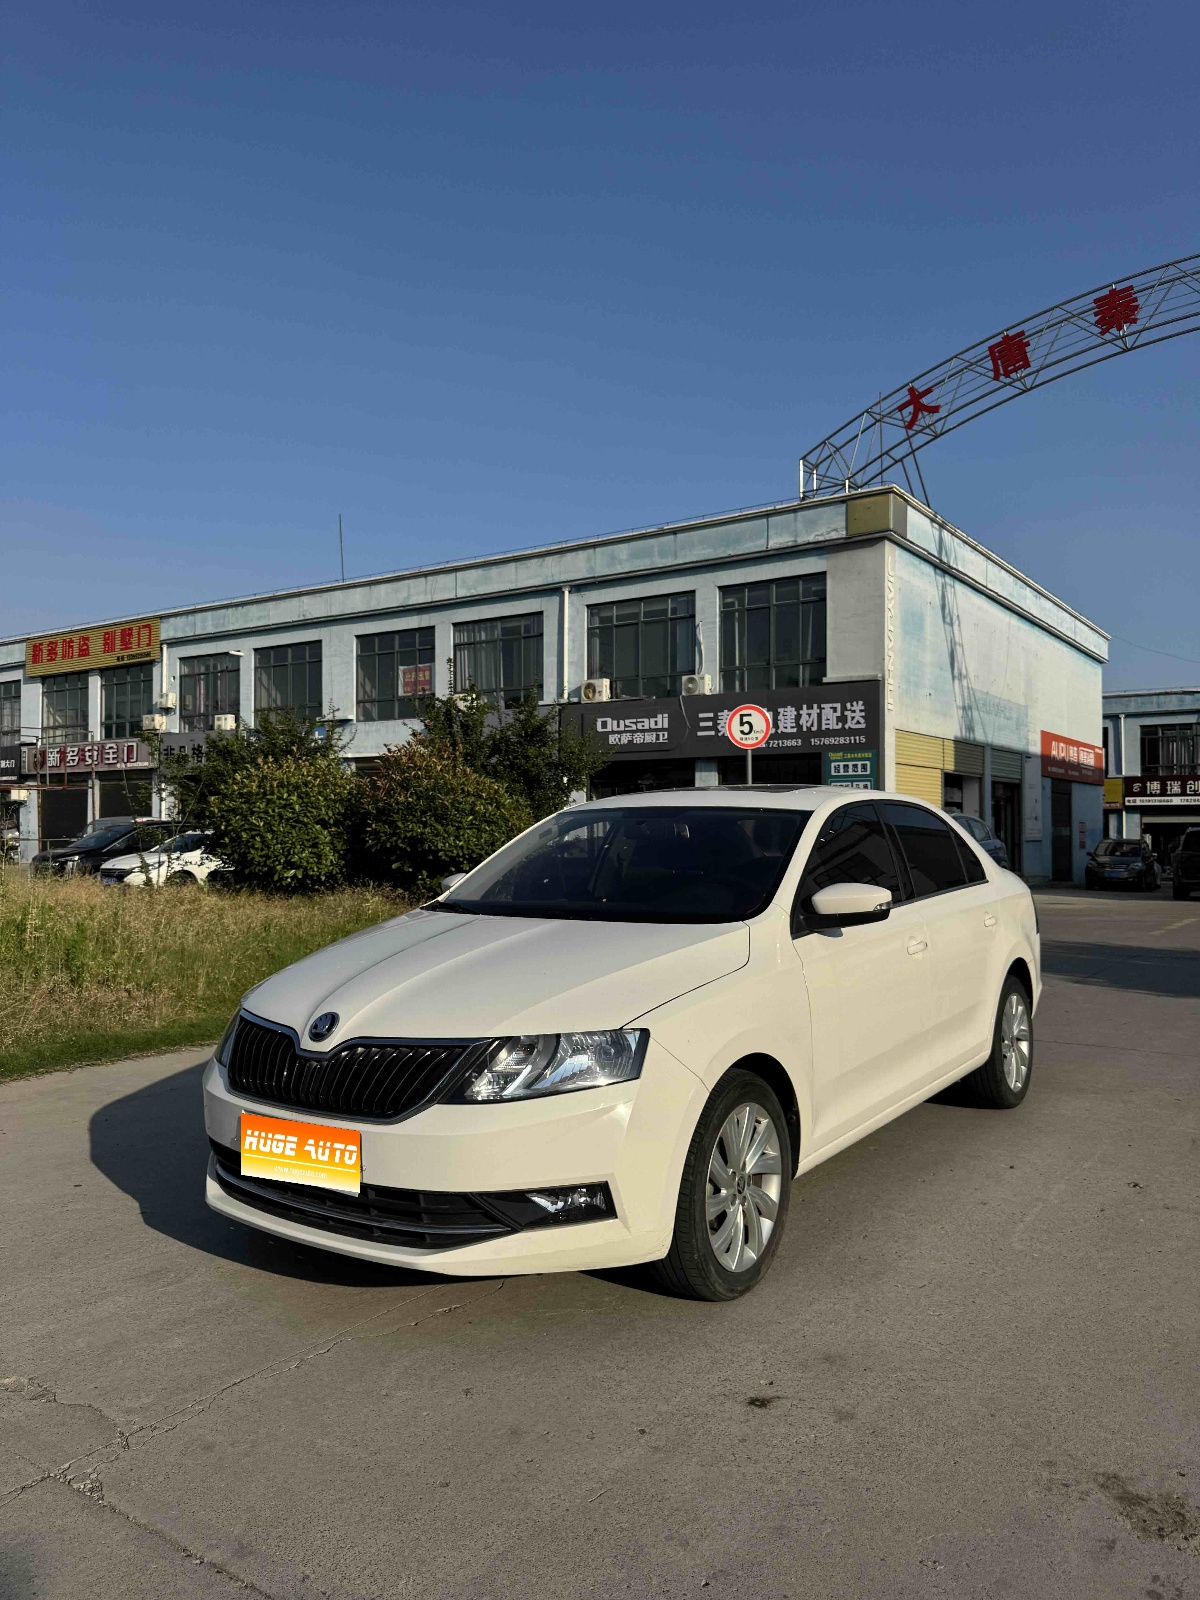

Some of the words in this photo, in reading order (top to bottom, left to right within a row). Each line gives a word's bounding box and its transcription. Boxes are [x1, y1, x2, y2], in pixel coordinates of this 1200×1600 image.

[31, 636, 90, 664] 新多防盗
[102, 624, 152, 653] 别墅门
[739, 713, 754, 735] 5
[608, 731, 669, 744] 欧萨帝厨卫
[810, 736, 866, 746] 15769283115
[47, 743, 137, 767] 新多安全门
[833, 763, 868, 774] 经营范围
